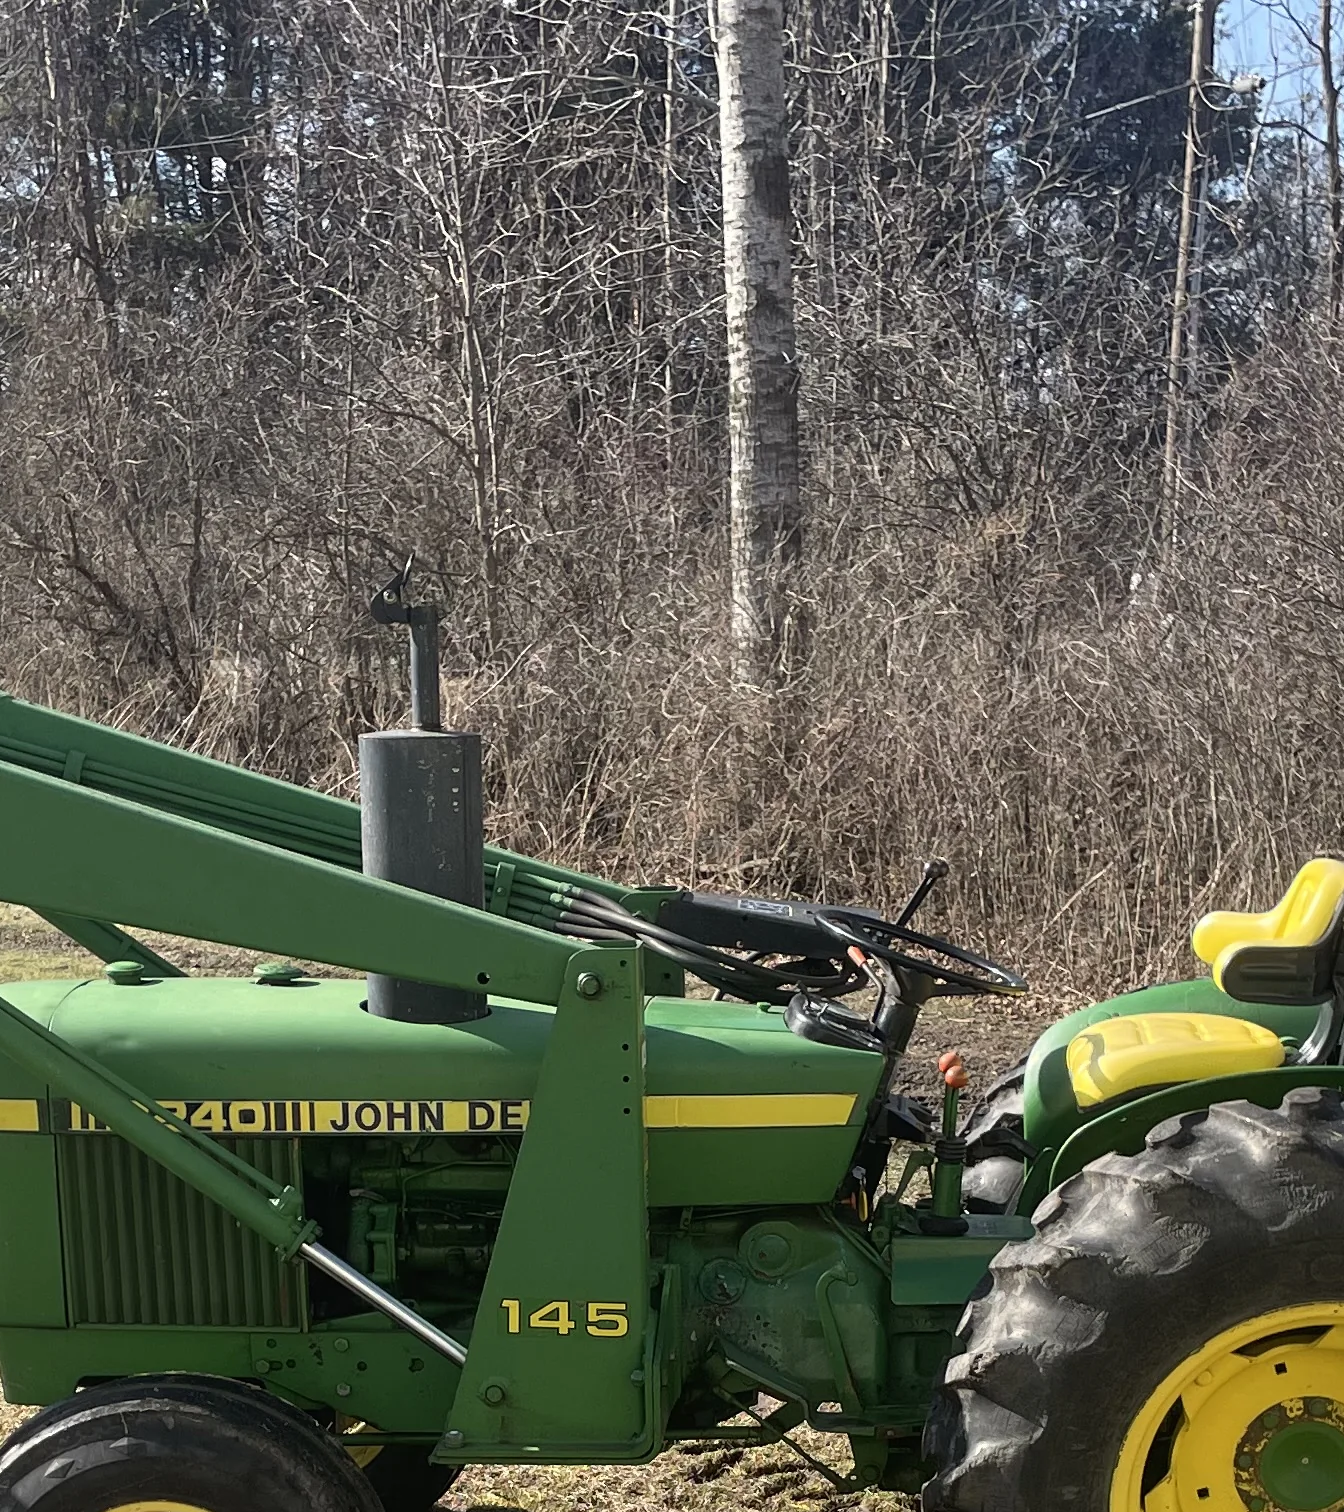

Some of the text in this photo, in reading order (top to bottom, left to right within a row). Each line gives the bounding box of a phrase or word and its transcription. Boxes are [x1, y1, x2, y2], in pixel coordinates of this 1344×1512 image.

[130, 1101, 265, 1132] 240
[329, 1102, 445, 1132] JOHN
[500, 1299, 629, 1338] 145
